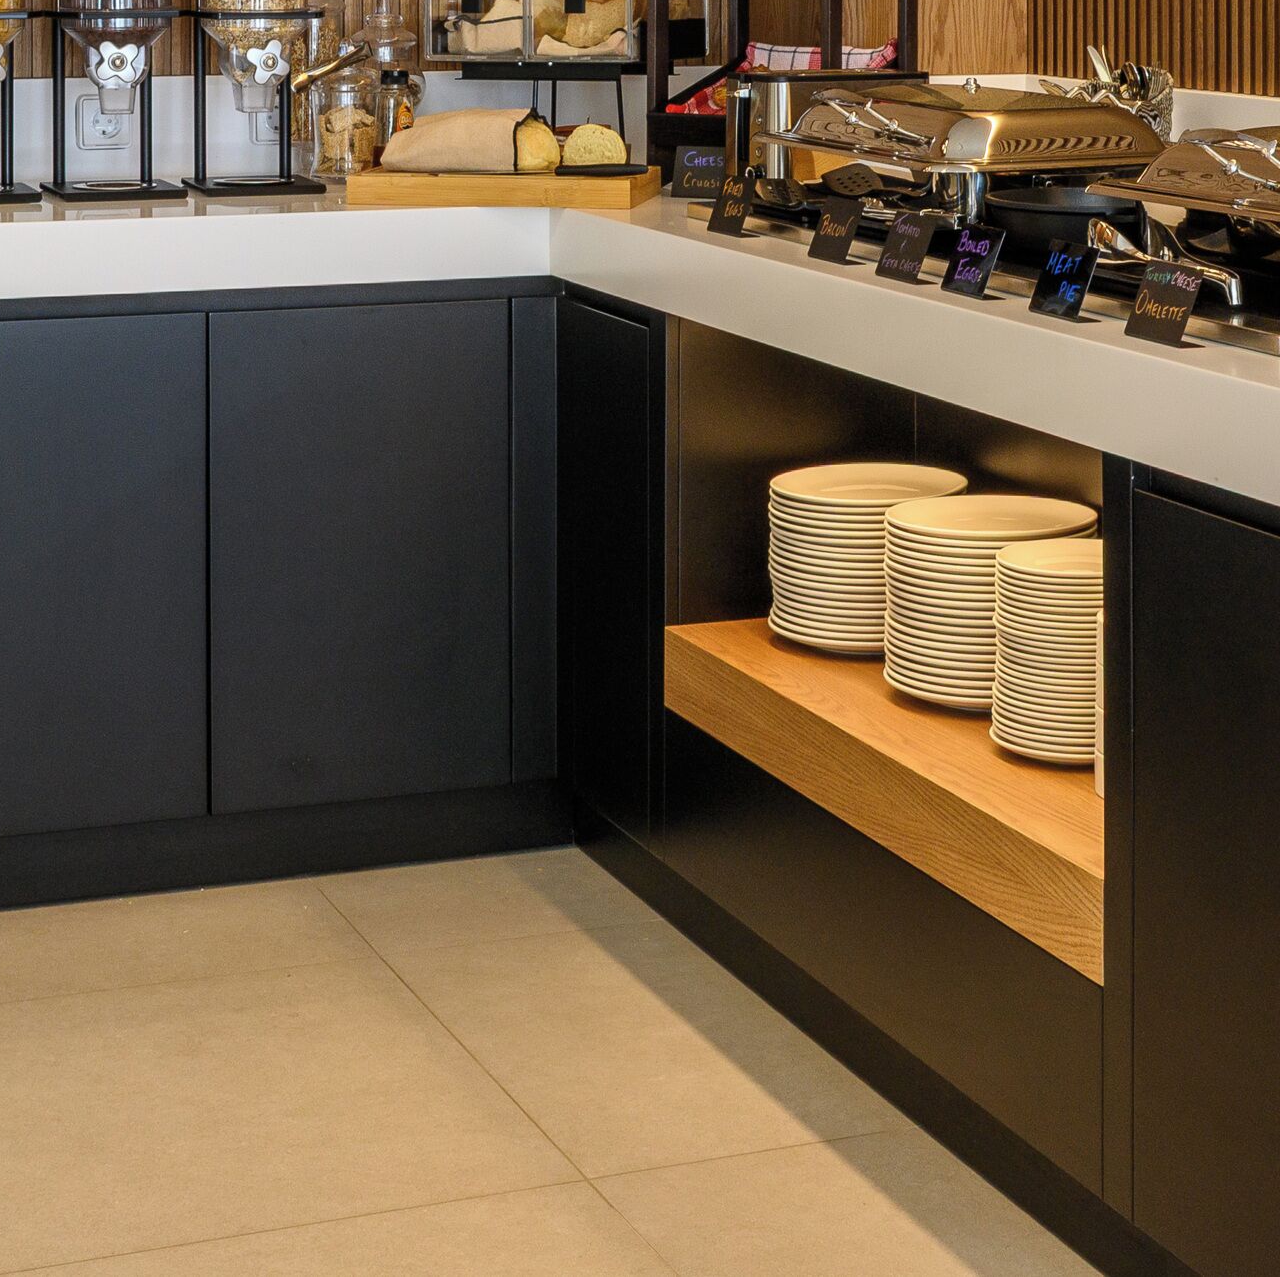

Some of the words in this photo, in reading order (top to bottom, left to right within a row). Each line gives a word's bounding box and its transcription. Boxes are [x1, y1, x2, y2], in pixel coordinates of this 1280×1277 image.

[684, 151, 724, 167] CHEES
[722, 176, 743, 197] FRIED
[724, 200, 744, 217] EGGS
[820, 213, 855, 237] BACON
[893, 213, 921, 238] TOMATO
[957, 229, 990, 256] BOILED
[954, 258, 980, 283] EGGS
[1046, 251, 1083, 275] MEAT
[1058, 281, 1080, 302] PIE
[1135, 289, 1188, 322] OMELETTE
